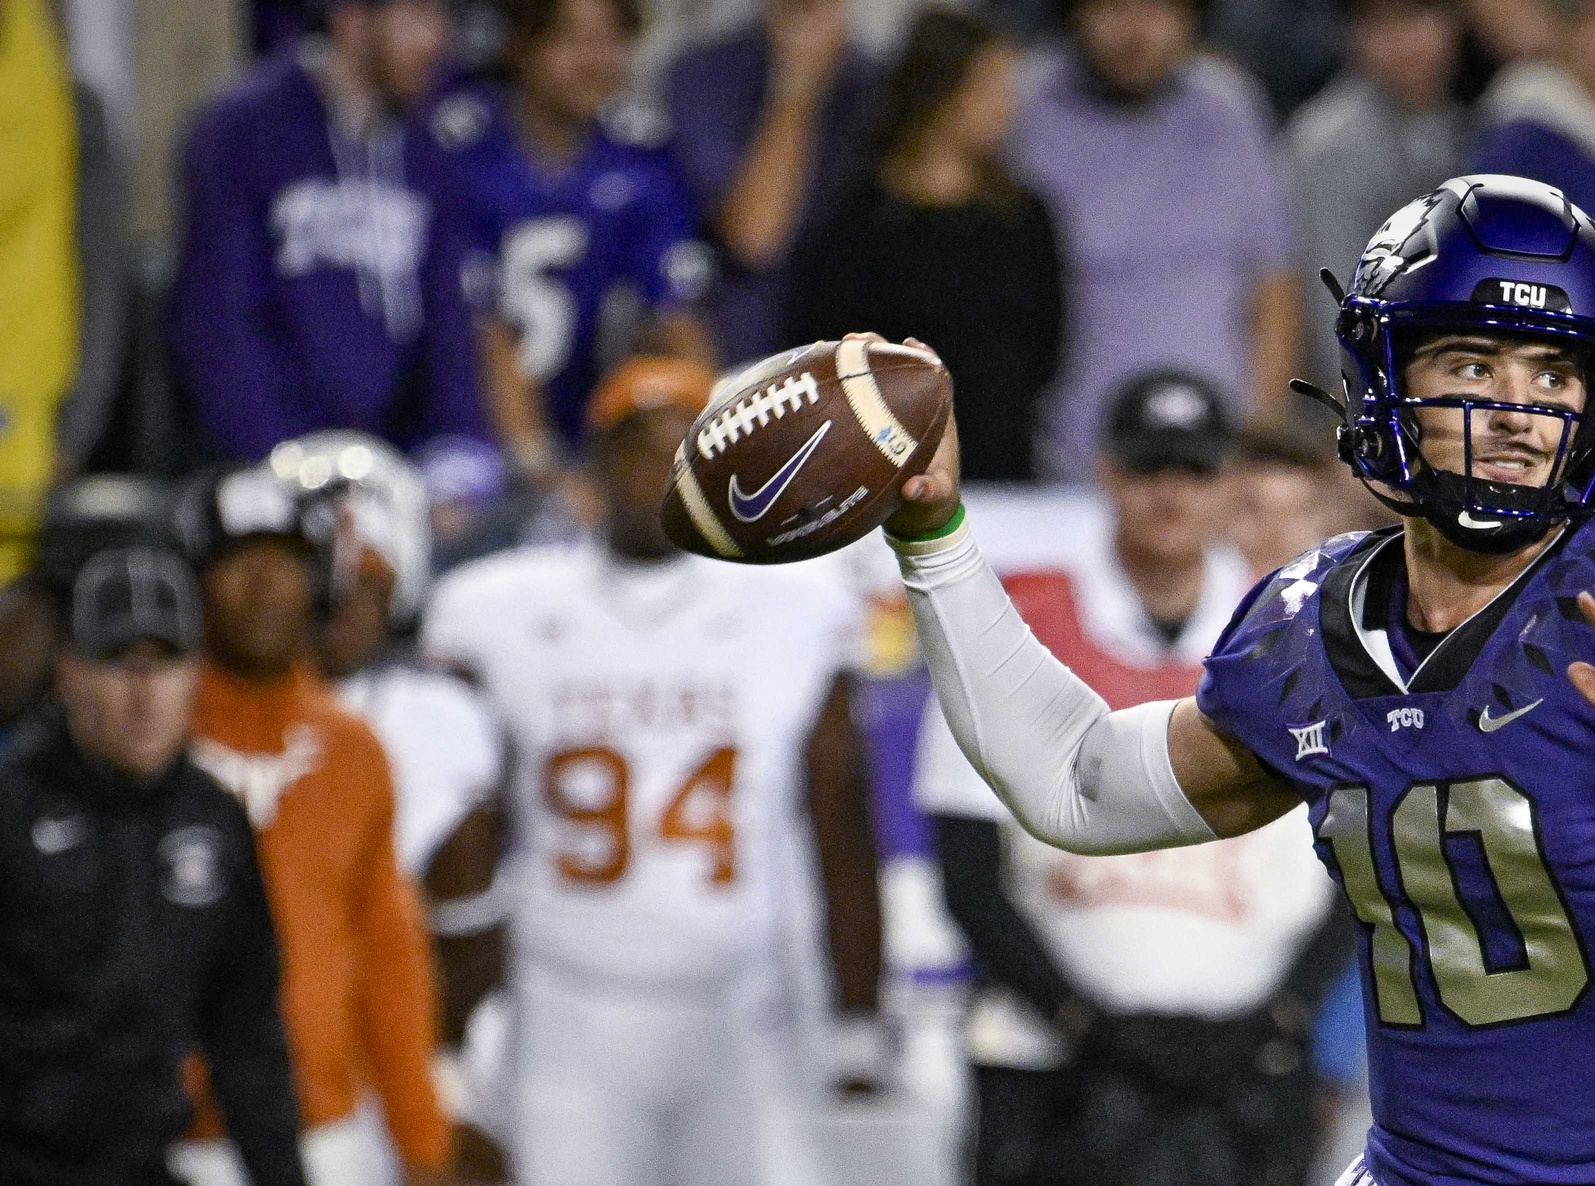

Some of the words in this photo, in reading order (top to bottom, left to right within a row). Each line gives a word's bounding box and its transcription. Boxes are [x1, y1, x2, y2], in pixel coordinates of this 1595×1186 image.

[499, 213, 590, 388] 5
[1499, 281, 1546, 309] TCU
[1288, 719, 1329, 762] XII
[1387, 708, 1424, 732] TCU
[543, 744, 739, 888] 94
[1314, 772, 1595, 1031] 10
